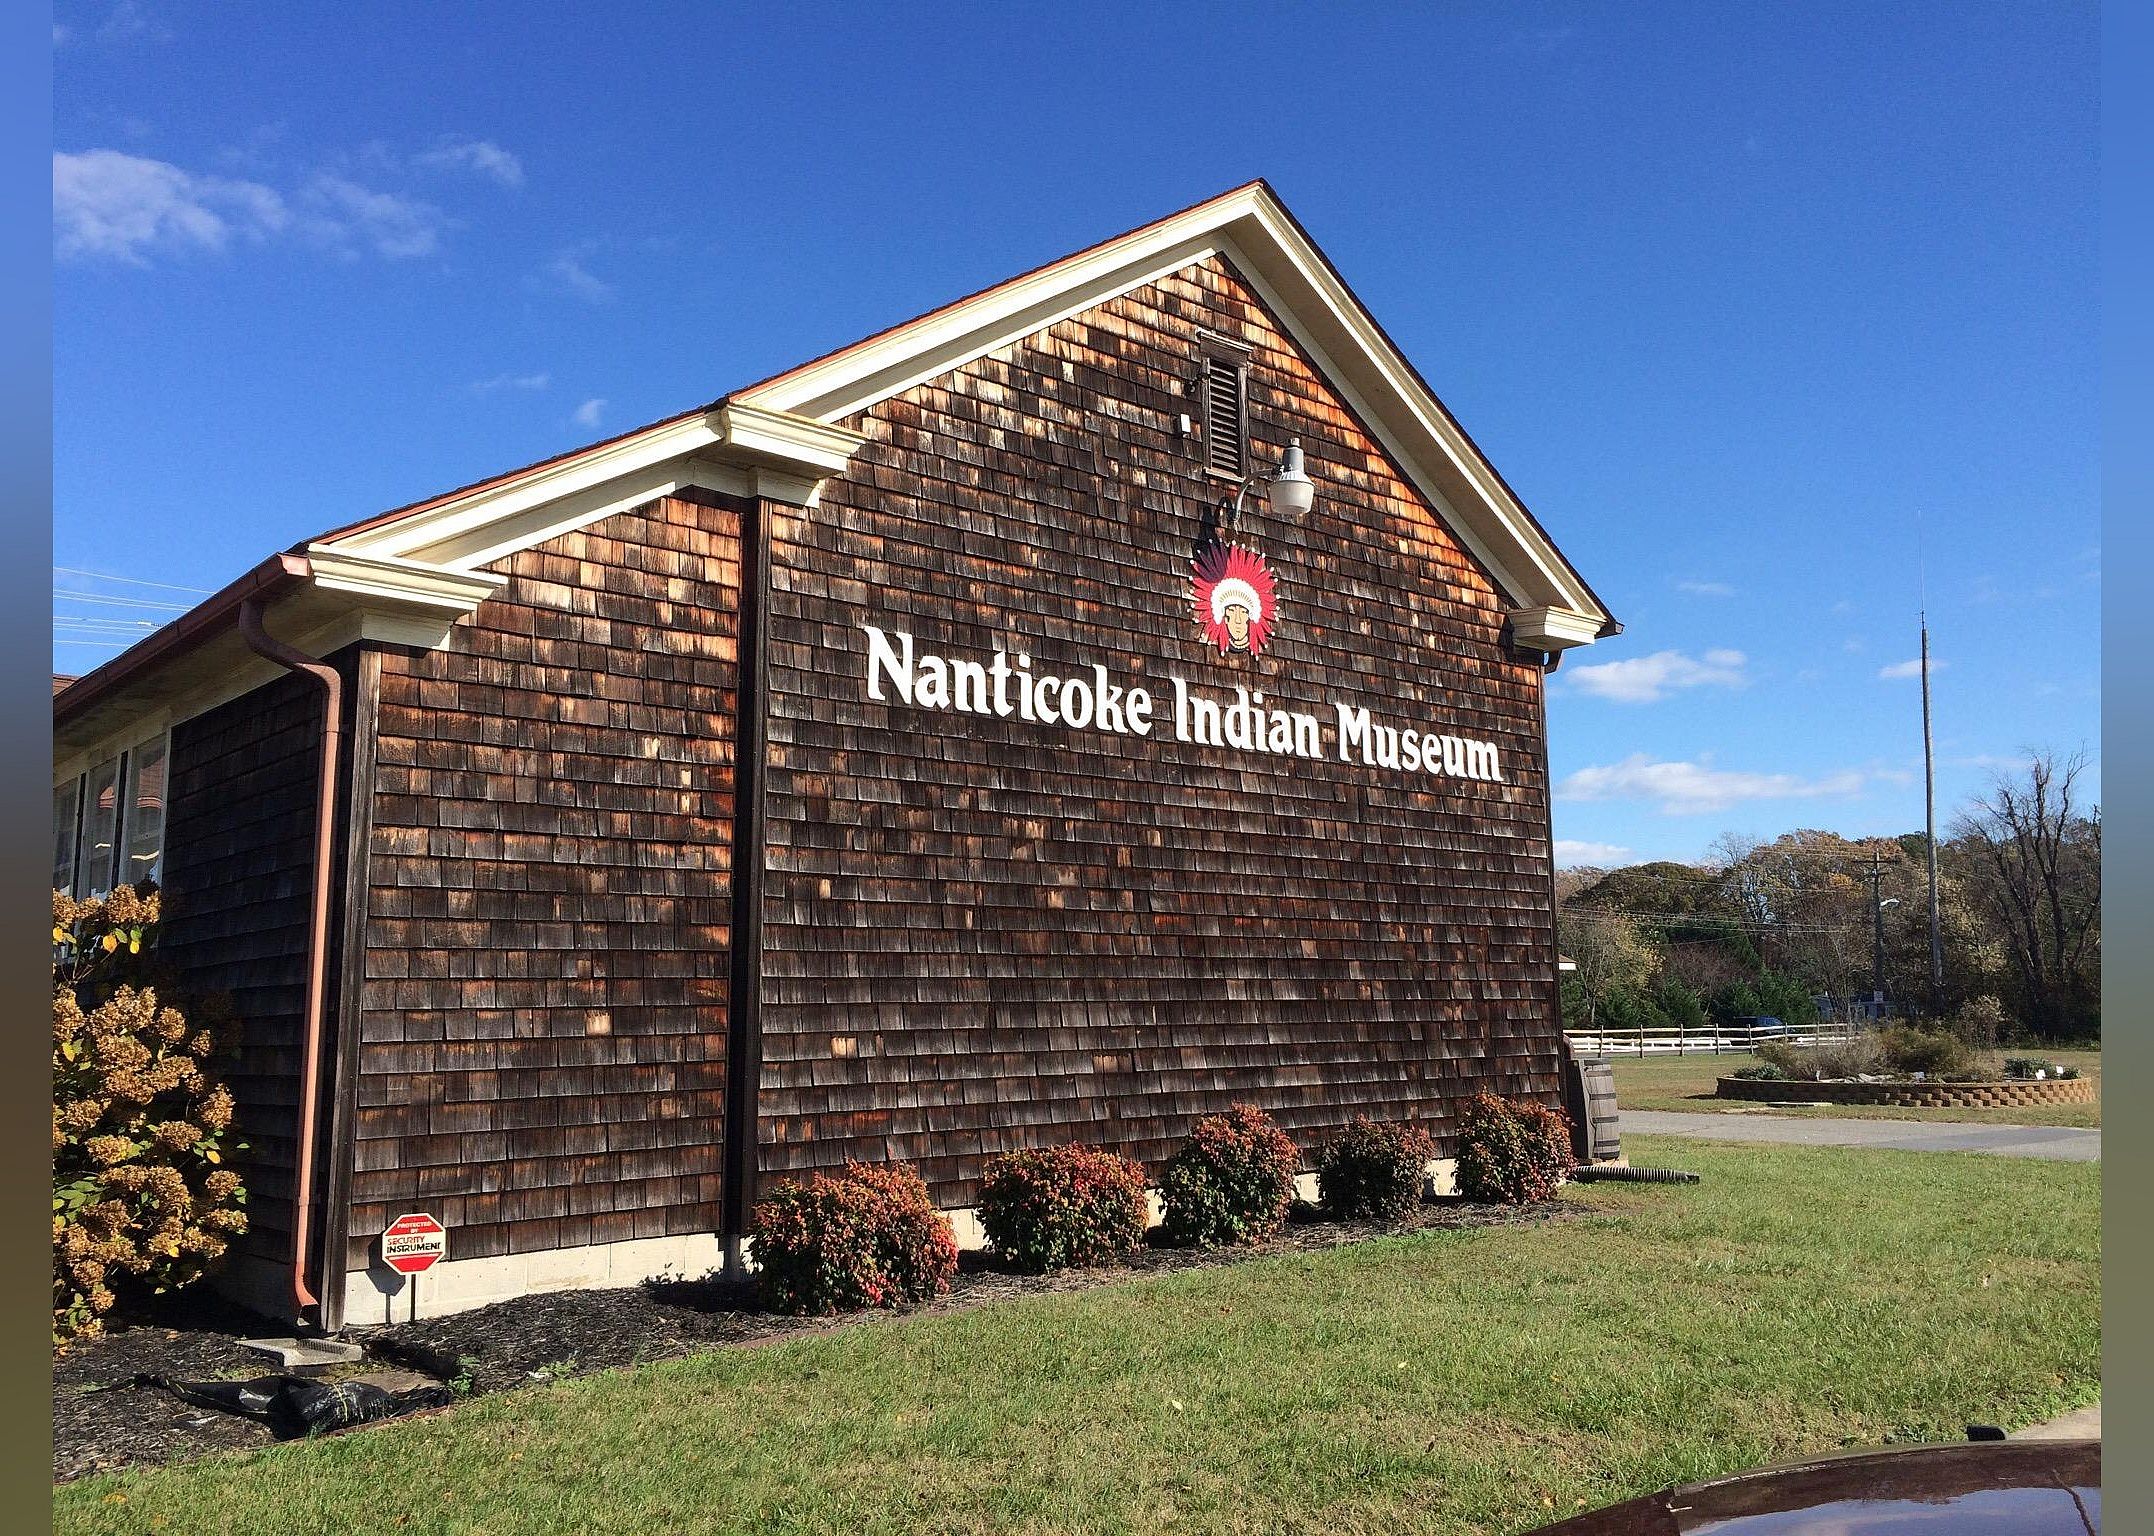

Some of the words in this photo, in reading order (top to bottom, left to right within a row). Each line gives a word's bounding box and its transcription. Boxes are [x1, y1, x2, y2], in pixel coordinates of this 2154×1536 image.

[864, 626, 1153, 736] Nanticoke
[1170, 677, 1323, 759] Indian
[1335, 703, 1504, 782] Museum
[387, 1236, 425, 1245] SECURITY
[386, 1242, 441, 1253] INSTRUMENT
